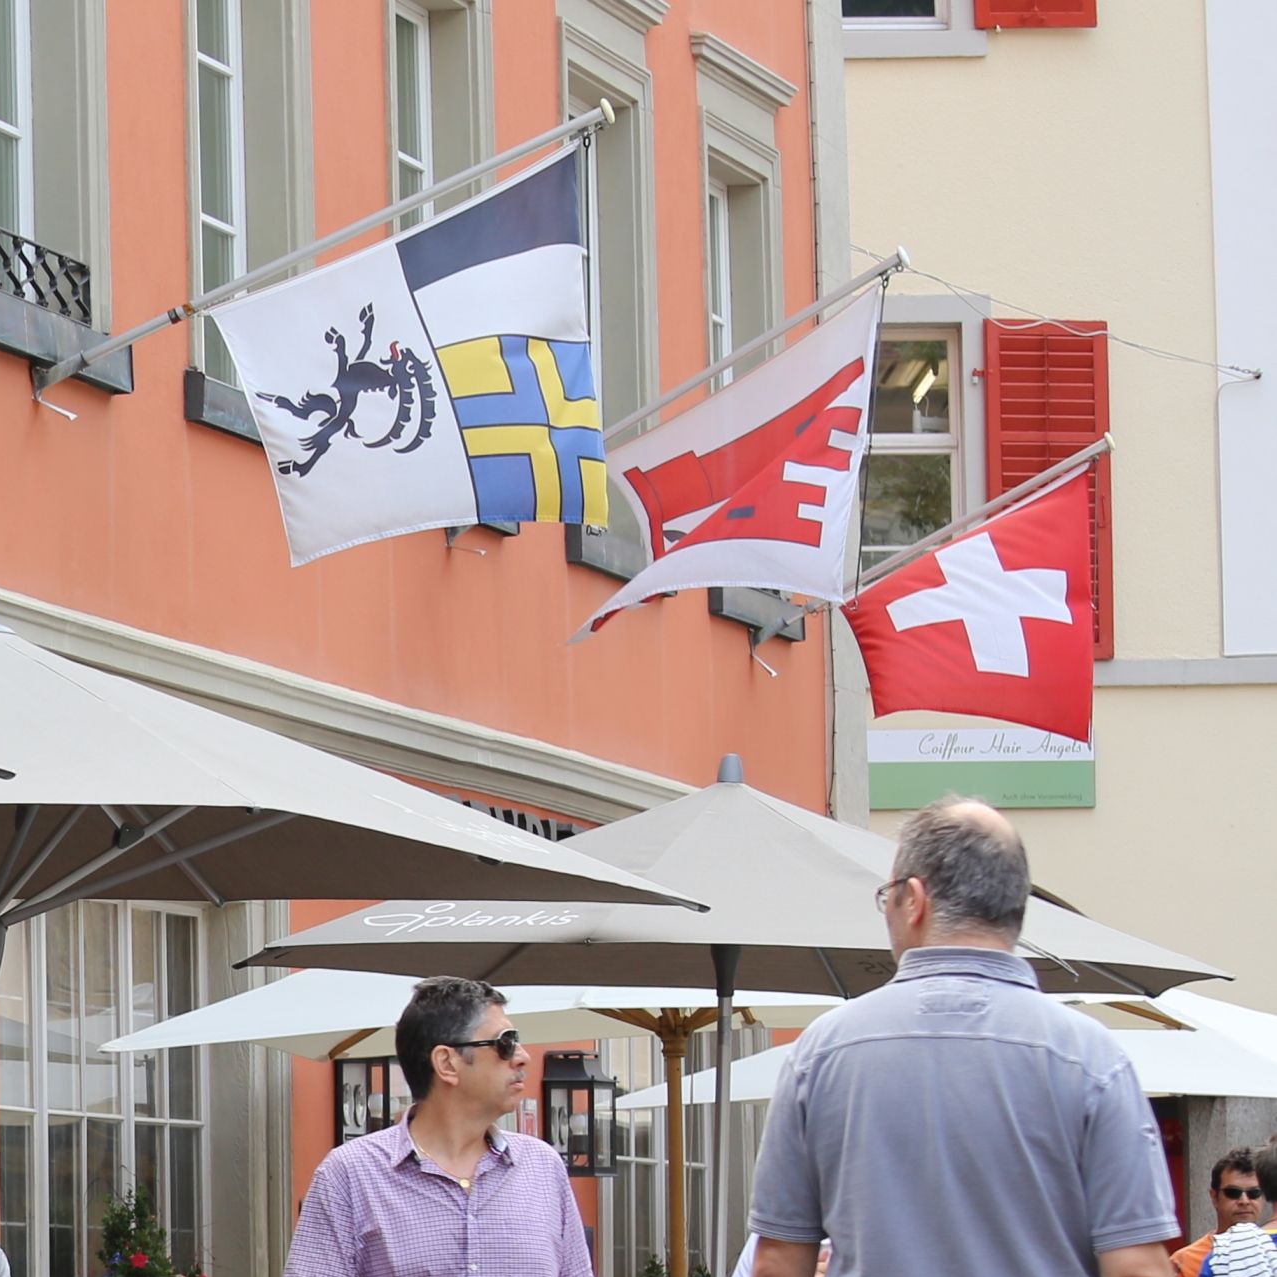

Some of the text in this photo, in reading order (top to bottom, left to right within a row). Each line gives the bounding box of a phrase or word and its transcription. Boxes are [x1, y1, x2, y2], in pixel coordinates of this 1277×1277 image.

[918, 733, 1082, 760] Coiffeur Hair Angels
